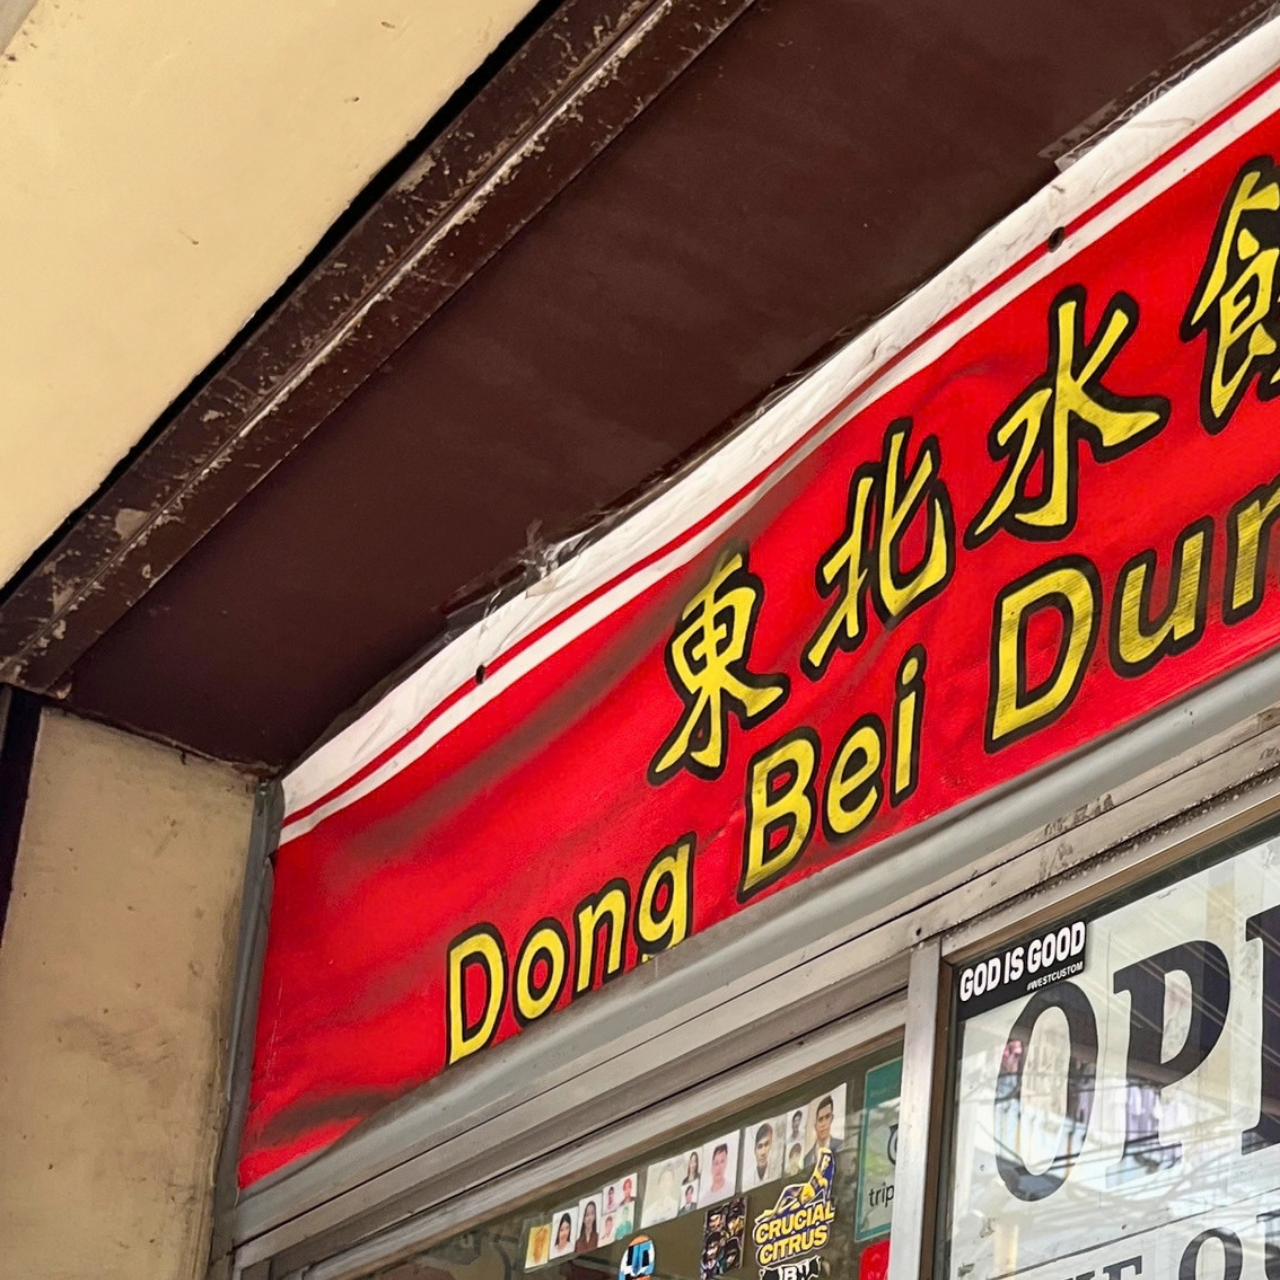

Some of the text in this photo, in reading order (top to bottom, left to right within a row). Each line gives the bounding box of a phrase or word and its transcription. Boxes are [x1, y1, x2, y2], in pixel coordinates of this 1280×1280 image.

[445, 830, 697, 1066] Dong
[737, 643, 926, 903] Bei
[960, 922, 1085, 1001] GOD IS GOOD
[1027, 961, 1083, 991] #WESTCUSTOM
[756, 1200, 834, 1244] CRUCIAL
[760, 1225, 827, 1264] CITRUS
